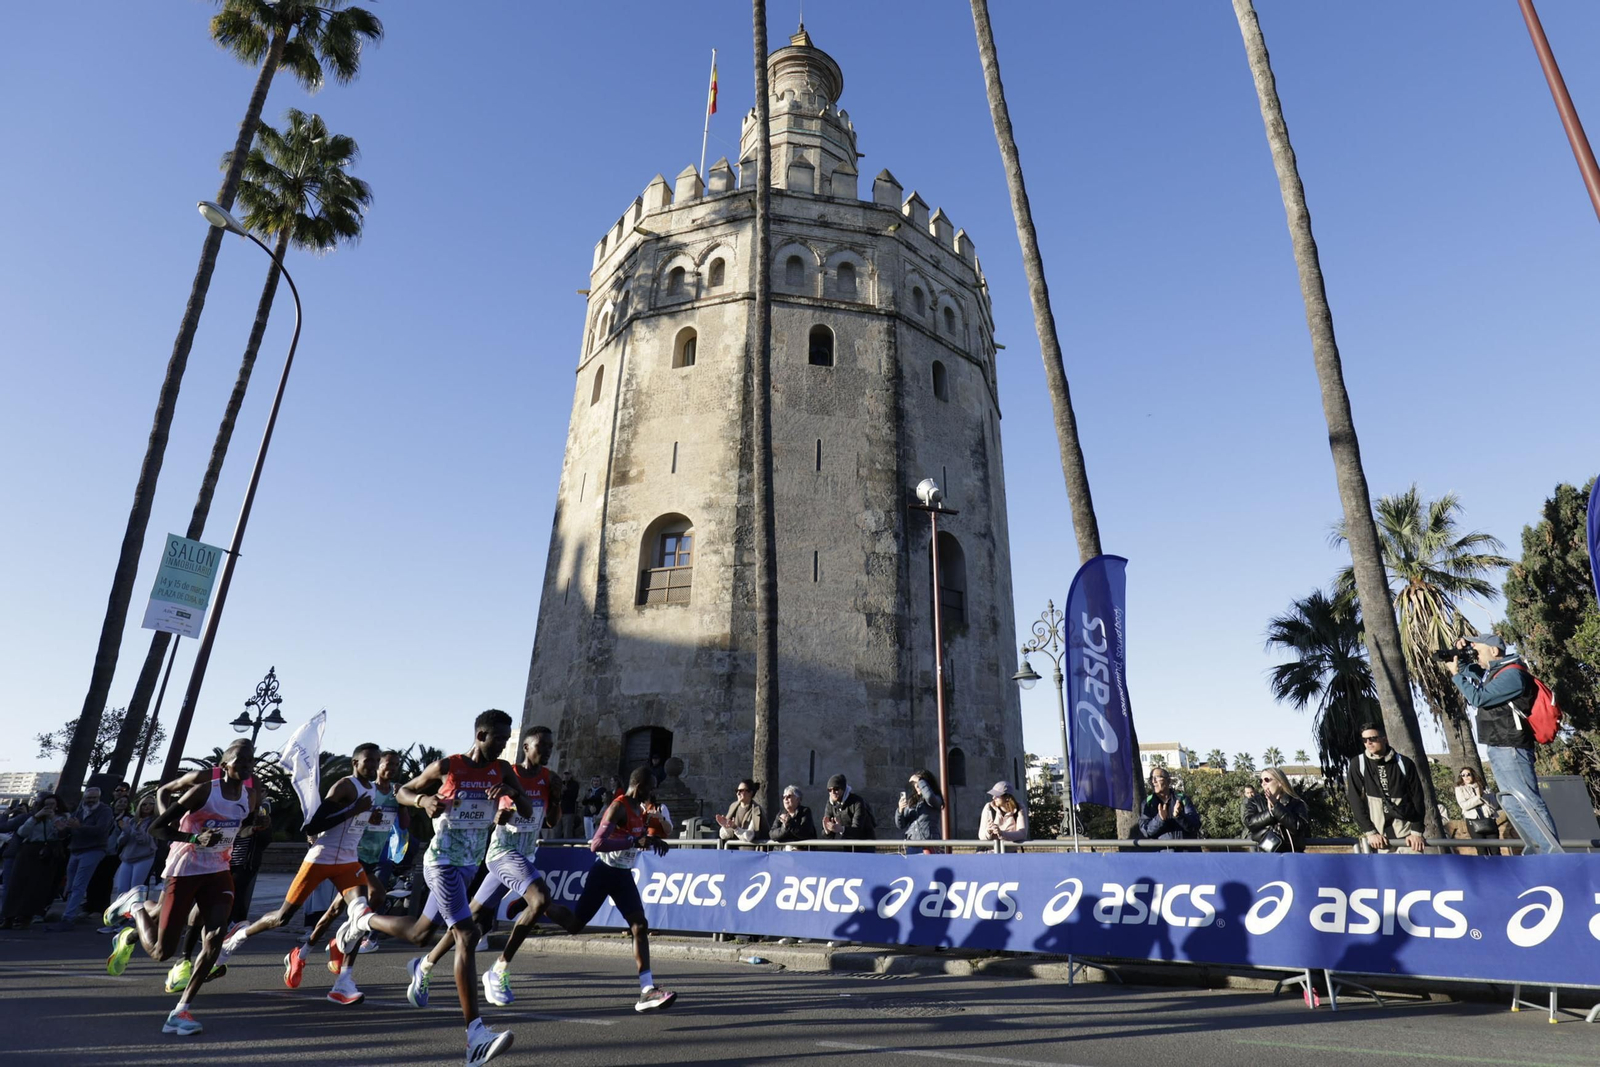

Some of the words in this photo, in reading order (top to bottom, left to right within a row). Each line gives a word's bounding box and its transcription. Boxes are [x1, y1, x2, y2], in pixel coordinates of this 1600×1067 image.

[169, 541, 216, 567] SALÓN
[165, 557, 212, 576] INMOBILIARIO
[158, 588, 176, 598] PLAZA
[176, 591, 184, 599] DE
[160, 577, 167, 586] 14
[167, 580, 172, 588] y
[174, 579, 181, 588] 15
[181, 581, 190, 591] de
[190, 585, 208, 596] marzo
[1113, 605, 1124, 629] body
[1114, 629, 1124, 659] sound
[1118, 688, 1128, 717] sound
[459, 811, 485, 820] PACER
